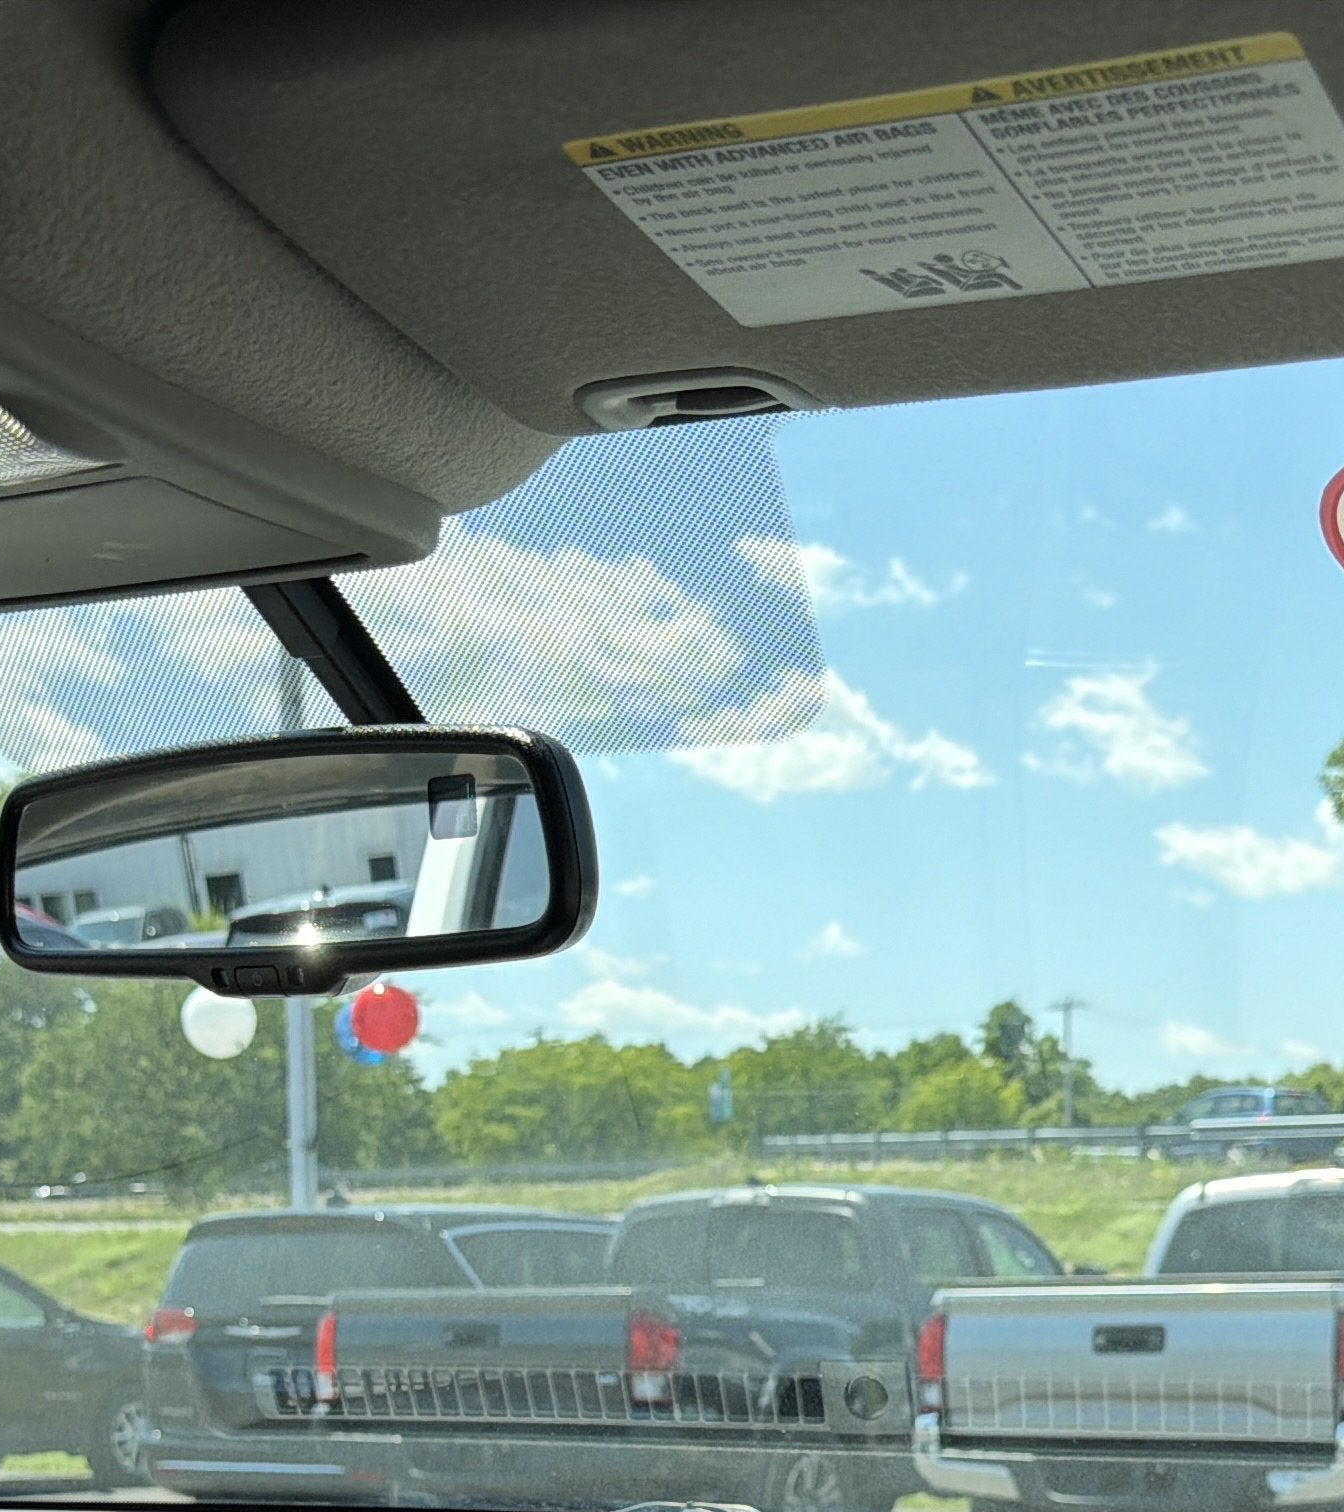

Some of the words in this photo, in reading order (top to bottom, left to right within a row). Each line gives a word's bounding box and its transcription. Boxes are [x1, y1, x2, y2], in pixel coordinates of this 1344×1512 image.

[1007, 46, 1243, 97] AVERTISSEMENT
[597, 162, 652, 182] EVEN
[654, 153, 711, 174] WITH
[711, 136, 827, 165] ADVANCED
[829, 129, 868, 148] AIR
[872, 119, 934, 141] BAGS
[620, 122, 742, 154] WARNING
